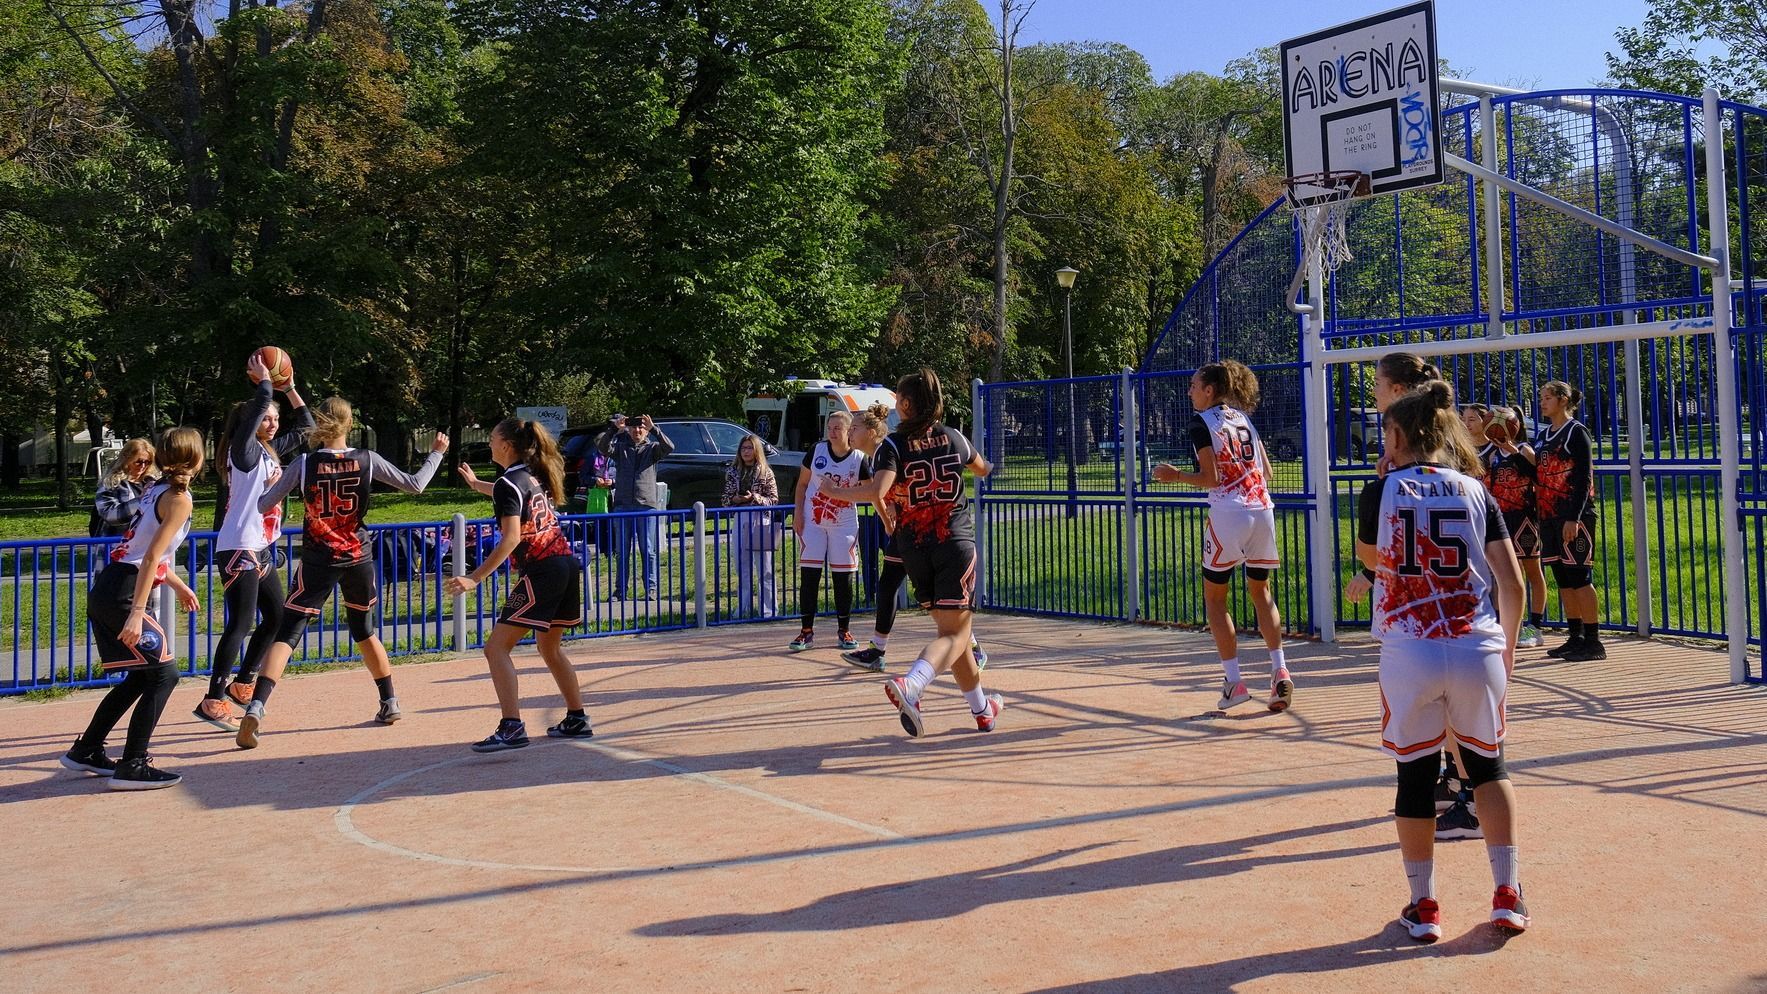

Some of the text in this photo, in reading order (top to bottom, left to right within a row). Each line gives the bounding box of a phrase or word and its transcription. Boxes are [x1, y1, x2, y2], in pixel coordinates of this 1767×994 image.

[1292, 37, 1426, 114] ARENA
[1346, 122, 1372, 135] DO NOT
[1344, 132, 1376, 145] HANG ON
[1344, 142, 1377, 155] THE RING
[1221, 425, 1255, 463] 18
[317, 460, 361, 475] ARIANA
[904, 453, 961, 507] 25
[317, 477, 361, 519] 15
[1397, 481, 1466, 498] ARIANA
[1396, 507, 1470, 578] 15
[1576, 538, 1586, 553] 8
